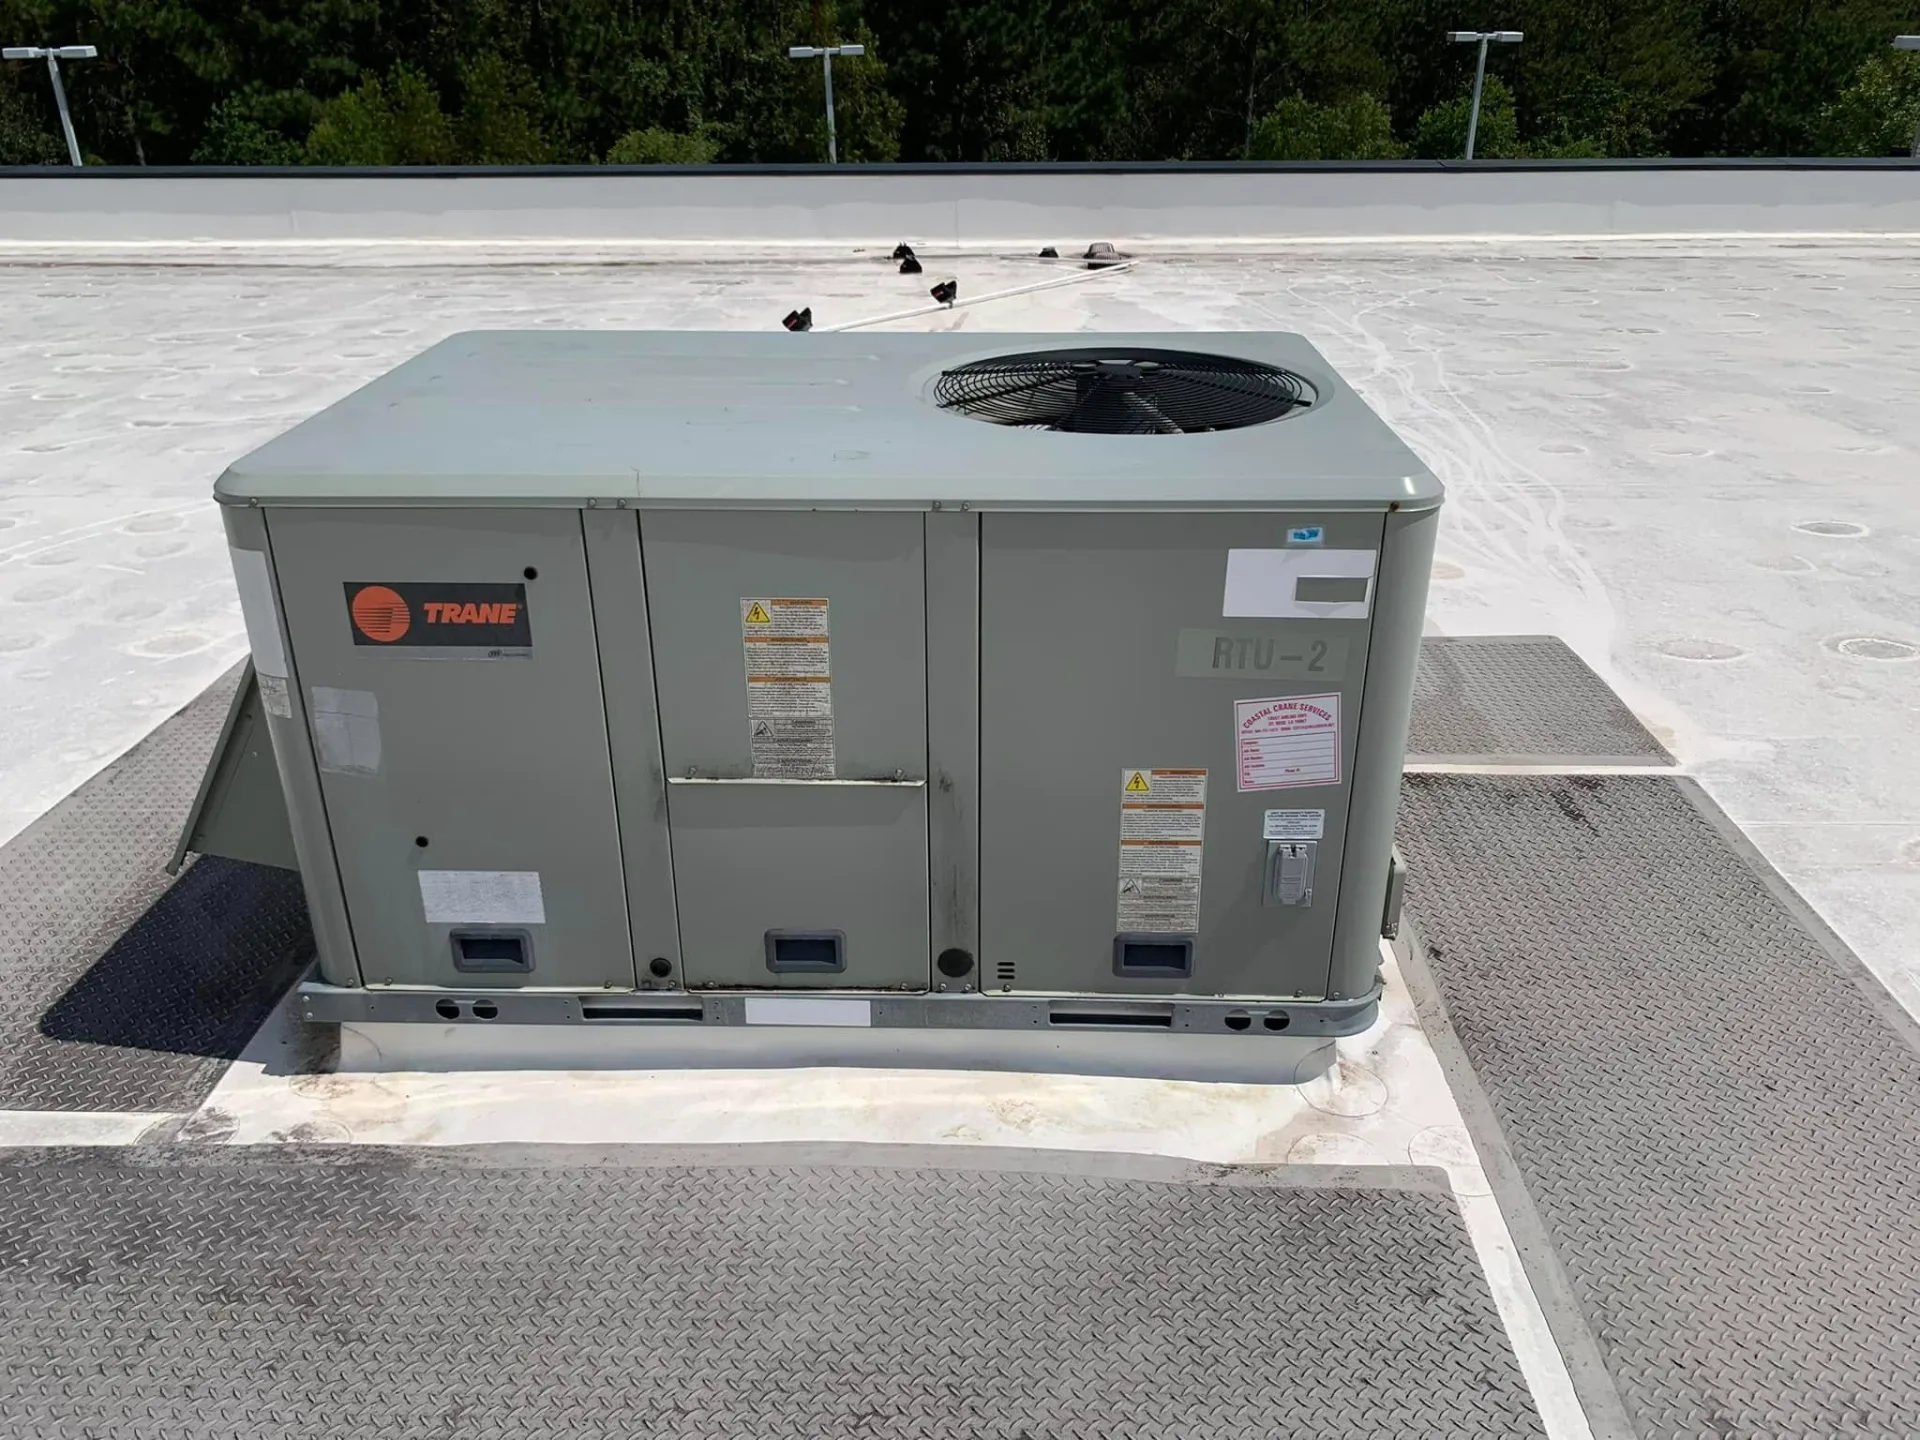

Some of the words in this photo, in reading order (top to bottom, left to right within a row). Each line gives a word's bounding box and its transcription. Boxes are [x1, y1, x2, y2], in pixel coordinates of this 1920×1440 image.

[424, 603, 517, 624] TRANE
[1212, 636, 1328, 672] RTU-2
[1243, 708, 1272, 728] COASTAL
[1273, 703, 1298, 712] CRANE
[1299, 703, 1332, 721] SERVICES
